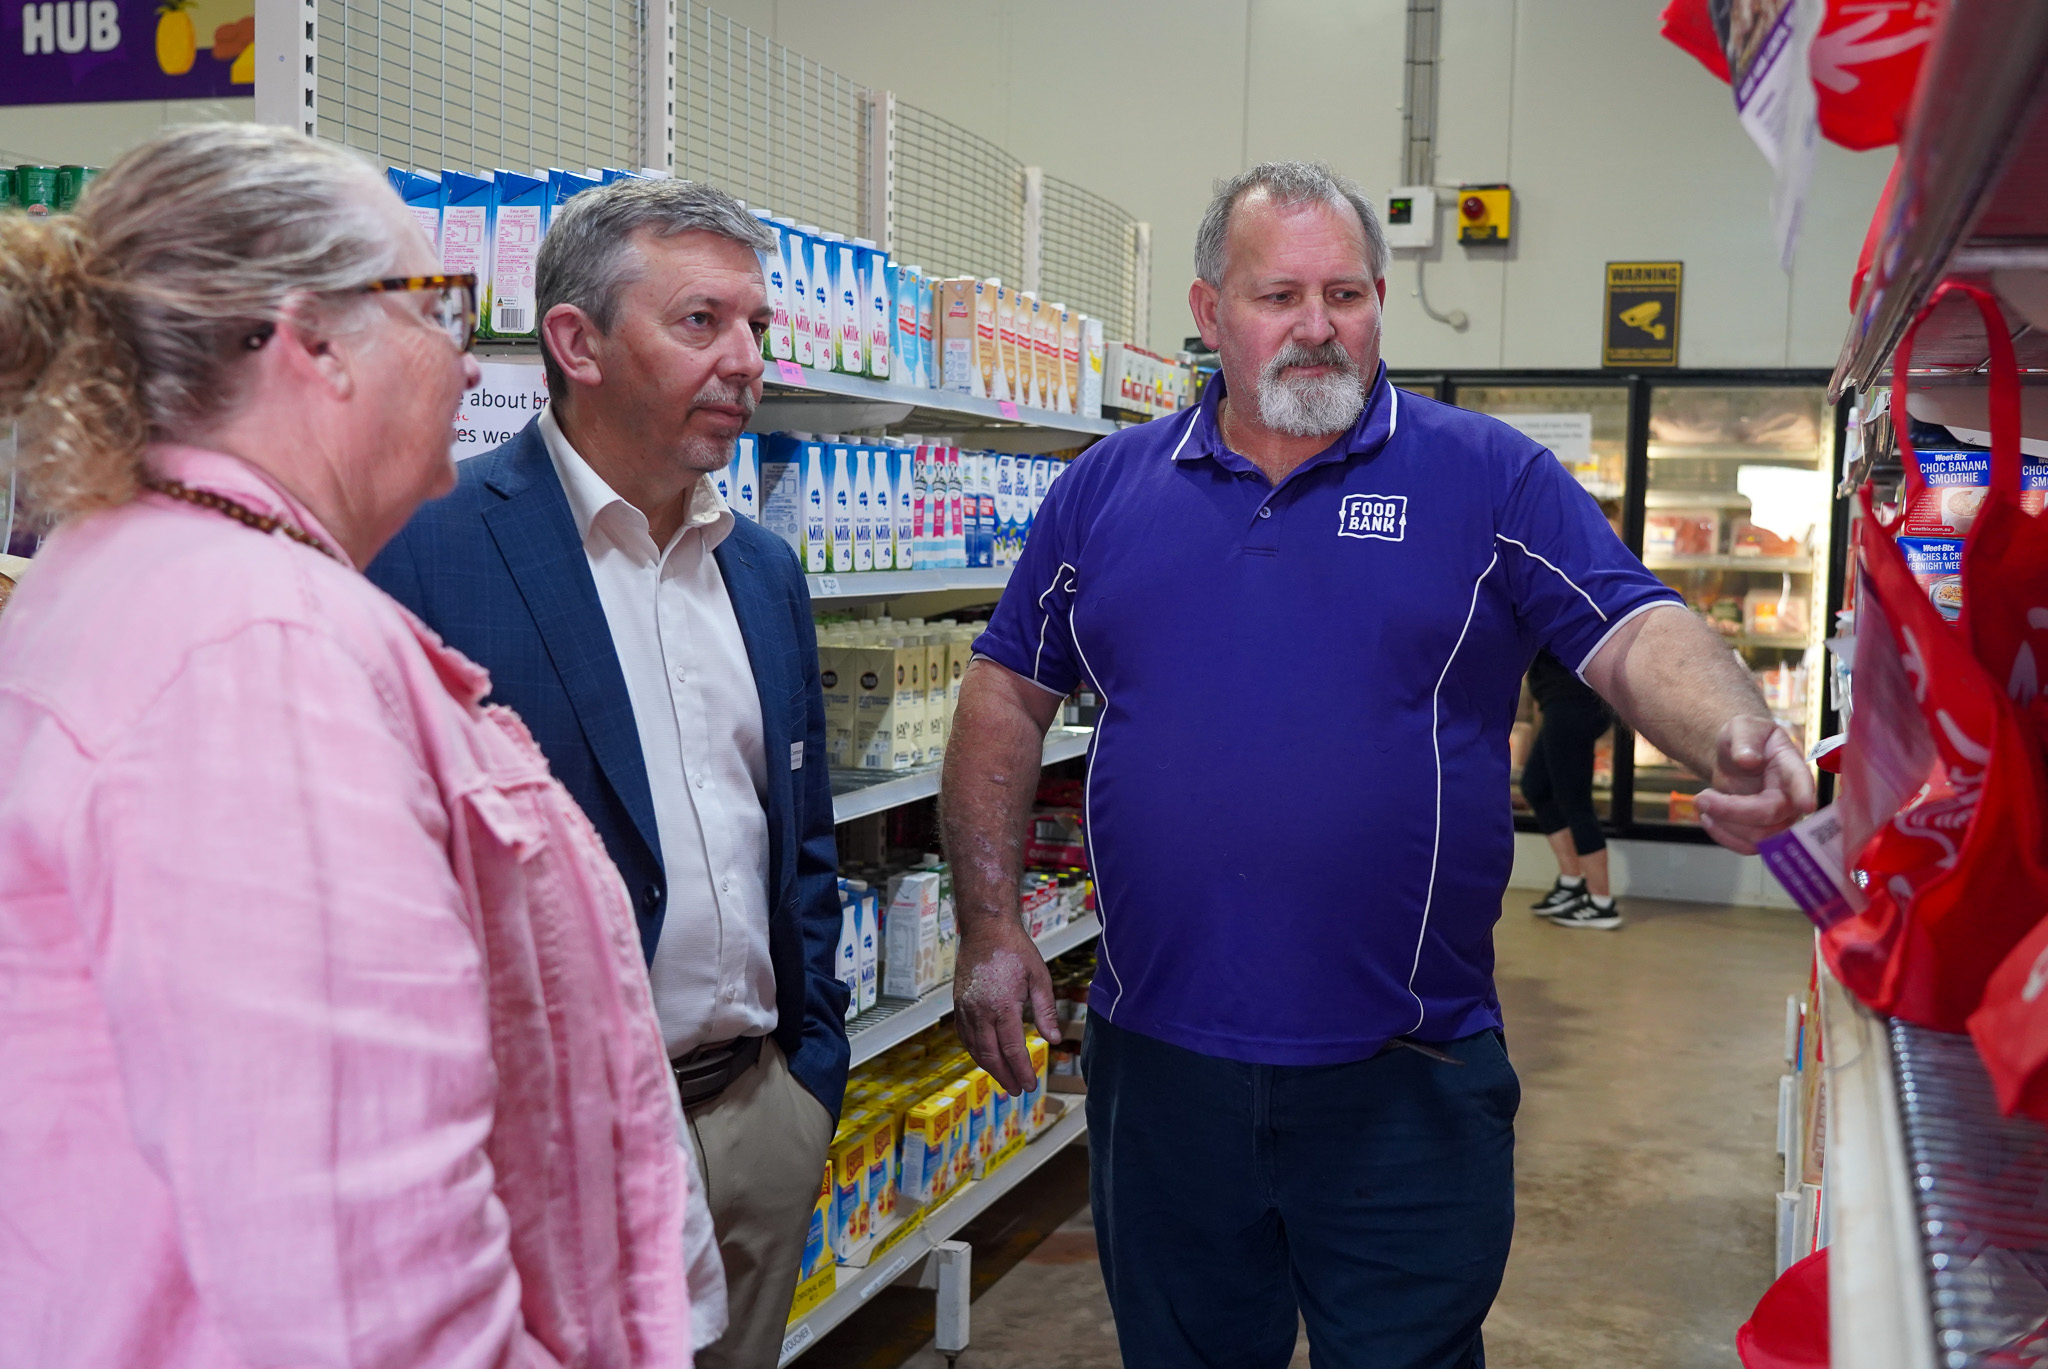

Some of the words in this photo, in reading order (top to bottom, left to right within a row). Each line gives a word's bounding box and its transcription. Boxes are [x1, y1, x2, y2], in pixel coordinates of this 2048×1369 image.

[22, 1, 121, 55] HUB
[1612, 267, 1677, 282] WARNING
[771, 308, 789, 328] Milk
[795, 313, 811, 333] Milk
[814, 321, 830, 340] Milk
[843, 323, 860, 342] Milk
[872, 329, 887, 347] Milk
[470, 388, 527, 410] about
[1935, 453, 1967, 462] Weet-Bix
[1919, 462, 1946, 474] CHOC
[1948, 460, 1988, 473] BANANA
[1928, 472, 1979, 485] SMOOTHIE
[1350, 501, 1396, 518] FOOD
[875, 524, 891, 541] Milk
[1348, 516, 1395, 533] BANK
[809, 525, 824, 541] Milk
[835, 525, 850, 541] Milk
[856, 525, 871, 541] Milk
[899, 525, 912, 541] Milk
[1922, 544, 1956, 552] Weet-Bix
[1907, 552, 1941, 562] PEACHES
[1906, 562, 1943, 571] VERNIGHT
[862, 964, 875, 983] Milk
[847, 975, 857, 990] ilk
[783, 1326, 810, 1352] VOUCHER
